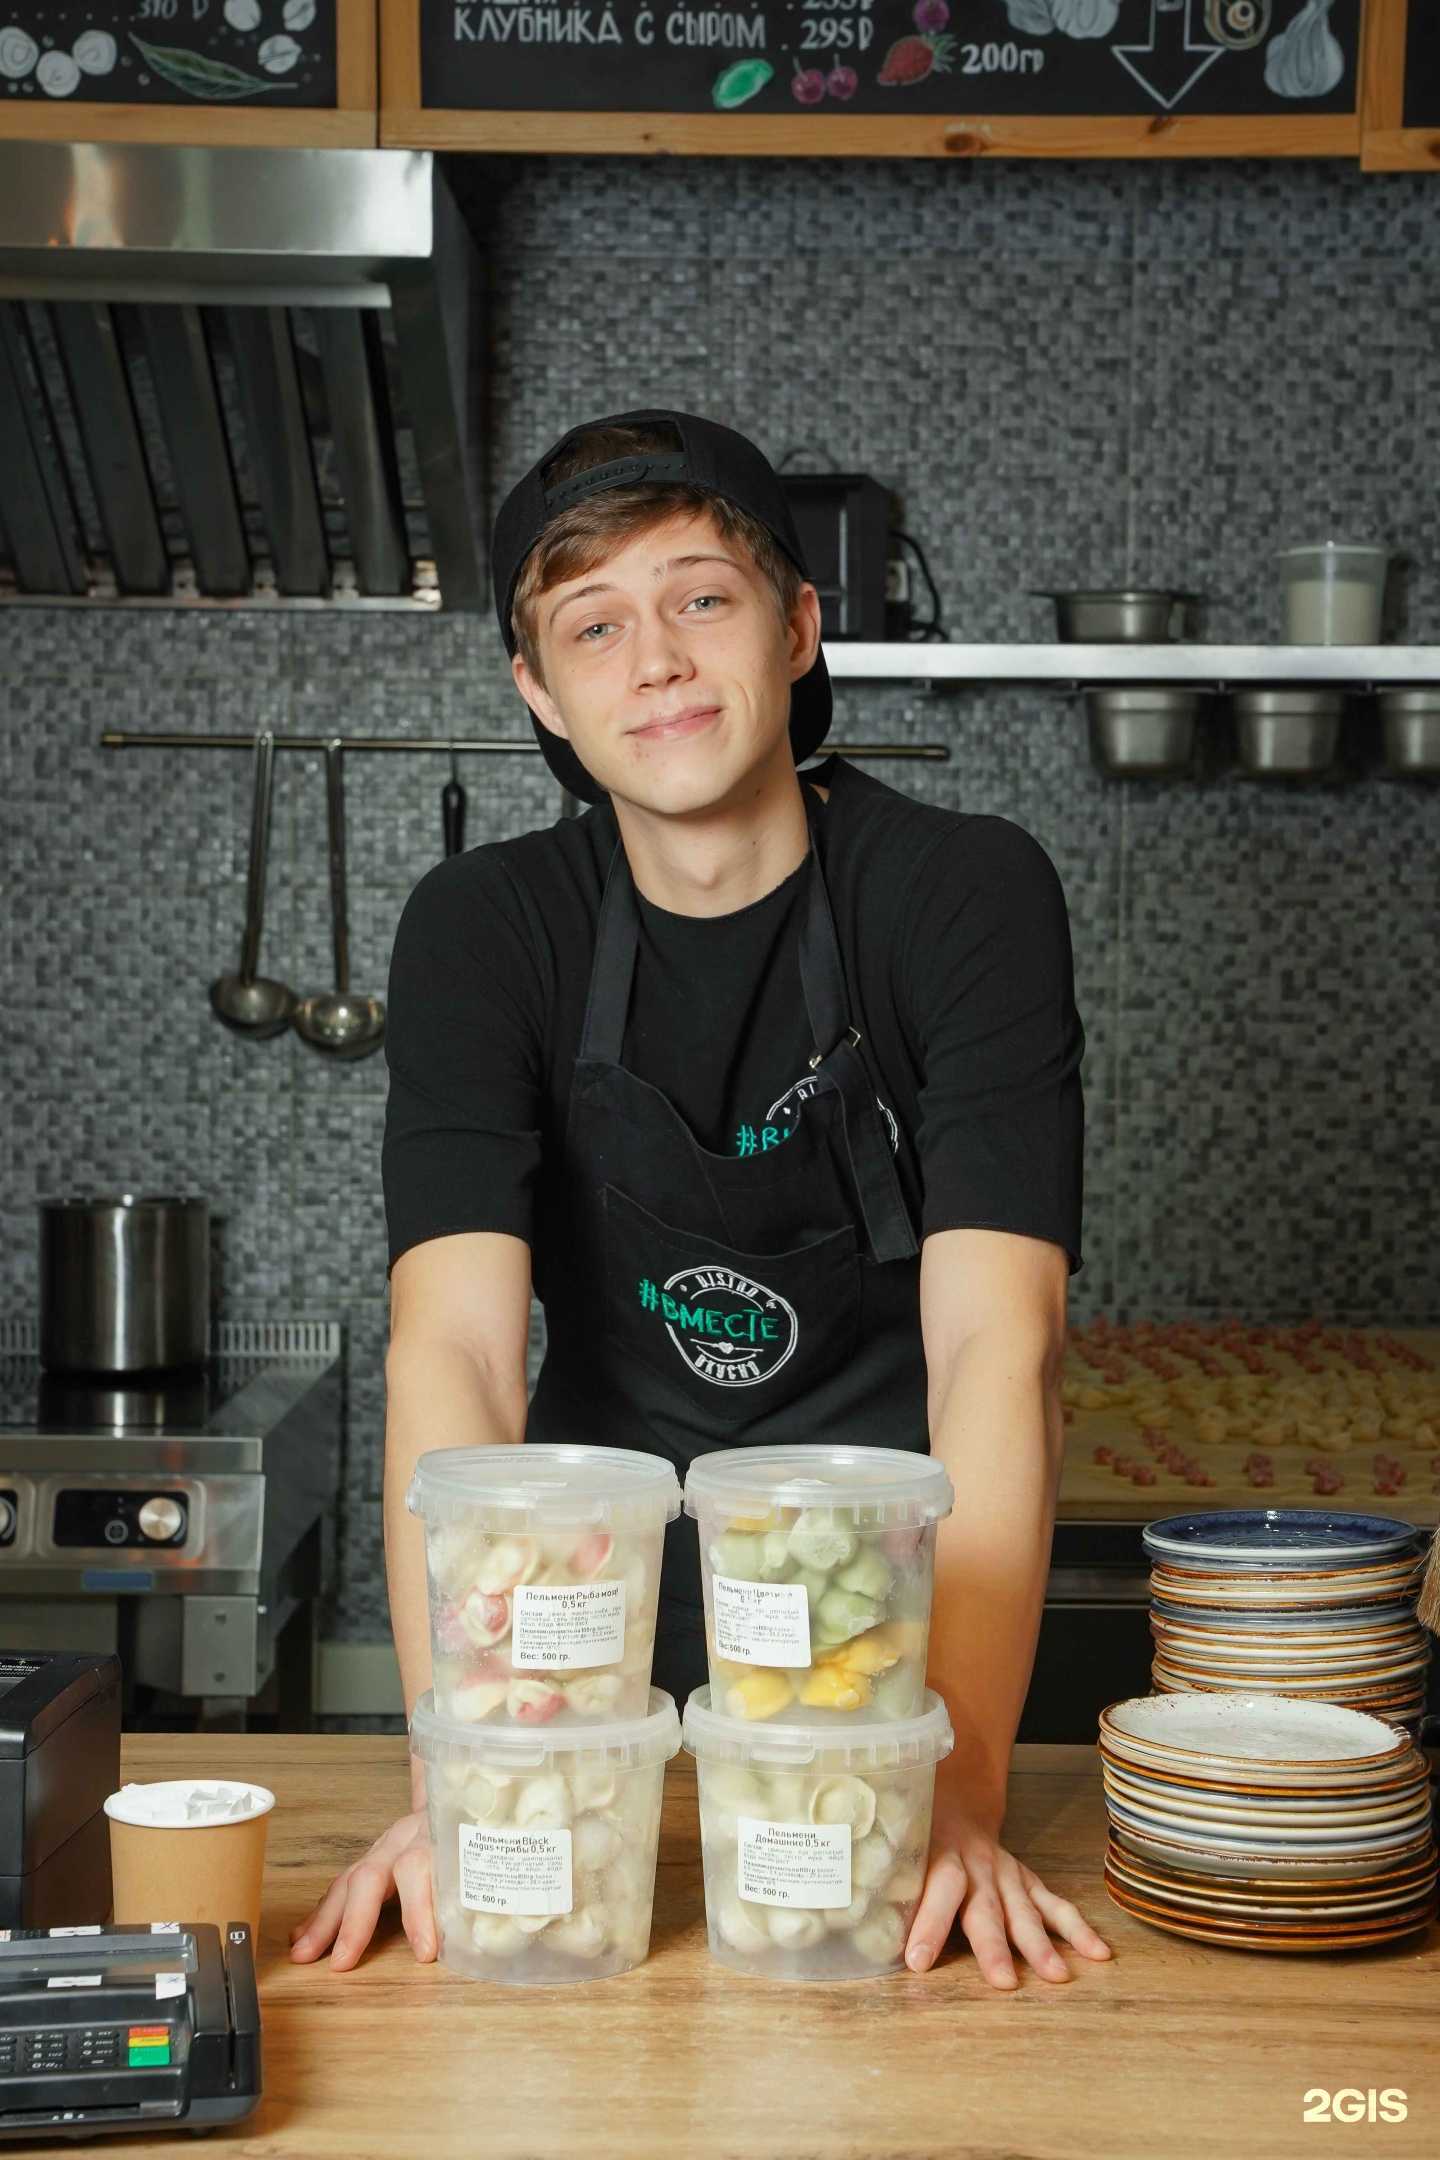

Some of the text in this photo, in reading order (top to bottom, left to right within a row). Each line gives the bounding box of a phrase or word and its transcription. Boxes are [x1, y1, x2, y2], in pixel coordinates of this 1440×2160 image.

[453, 7, 622, 43] КЛУБНИКА
[666, 11, 766, 48] СЫРОМ
[638, 1278, 779, 1342] #ВМЕСТЕ
[526, 1591, 575, 1601] Пельмени
[576, 1591, 600, 1600] Рыба
[562, 1601, 576, 1609] 0,5
[520, 1652, 539, 1660] Вес:
[542, 1653, 557, 1661] 500
[475, 1832, 549, 1845] Пельмени Black
[768, 1827, 816, 1839] Пельмени
[805, 1839, 819, 1848] 0,5
[745, 1883, 761, 1893] Вес:
[763, 1888, 777, 1896] 500
[482, 1895, 496, 1904] 500
